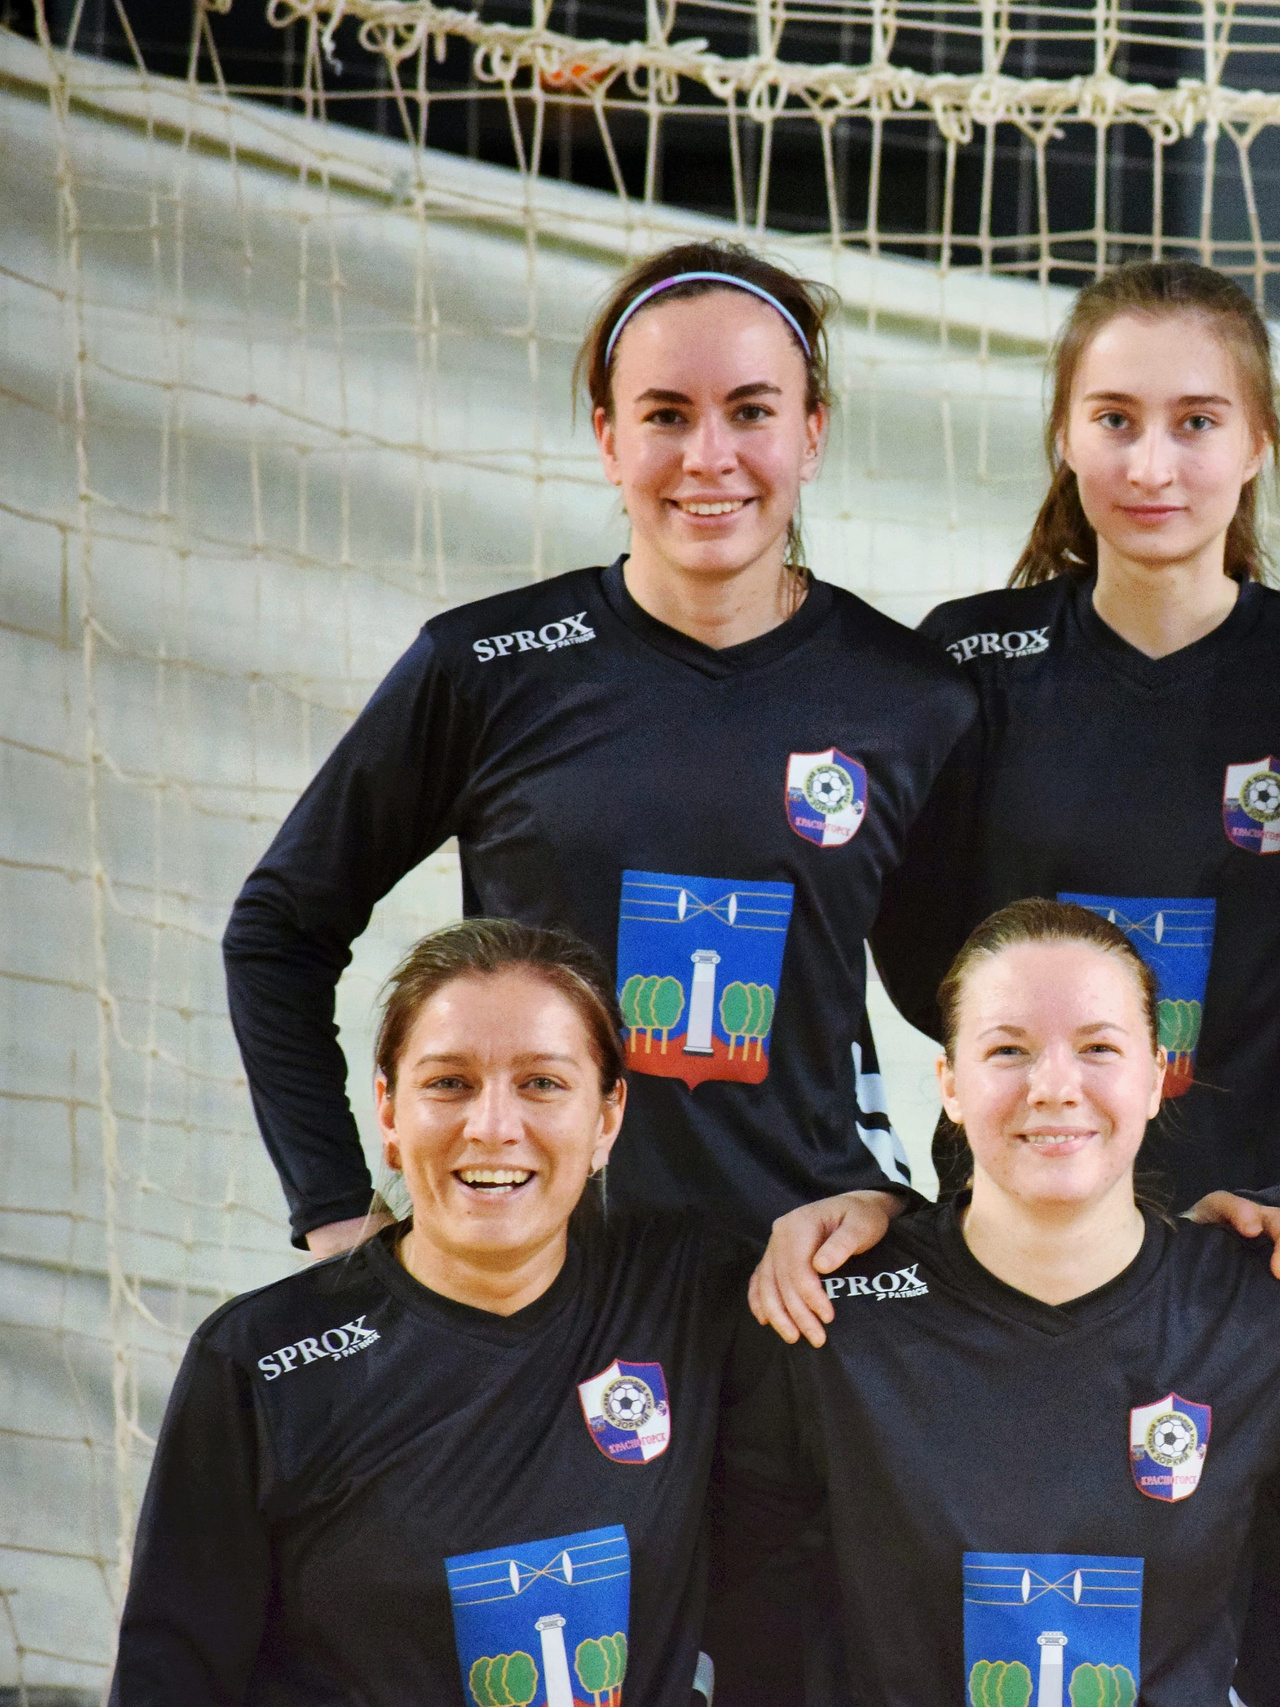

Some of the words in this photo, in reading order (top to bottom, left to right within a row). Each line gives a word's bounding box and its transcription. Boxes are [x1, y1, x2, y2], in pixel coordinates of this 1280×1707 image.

[472, 611, 594, 662] SPROX
[945, 626, 1050, 665] SPROX
[821, 1263, 927, 1300] PROX
[887, 1285, 930, 1300] PATRICK
[257, 1314, 377, 1381] SPROX
[342, 1331, 381, 1358] PATRICK
[608, 1432, 666, 1454] КРАСНОГОРСК
[1140, 1475, 1197, 1486] КРАСНОГОРСК
